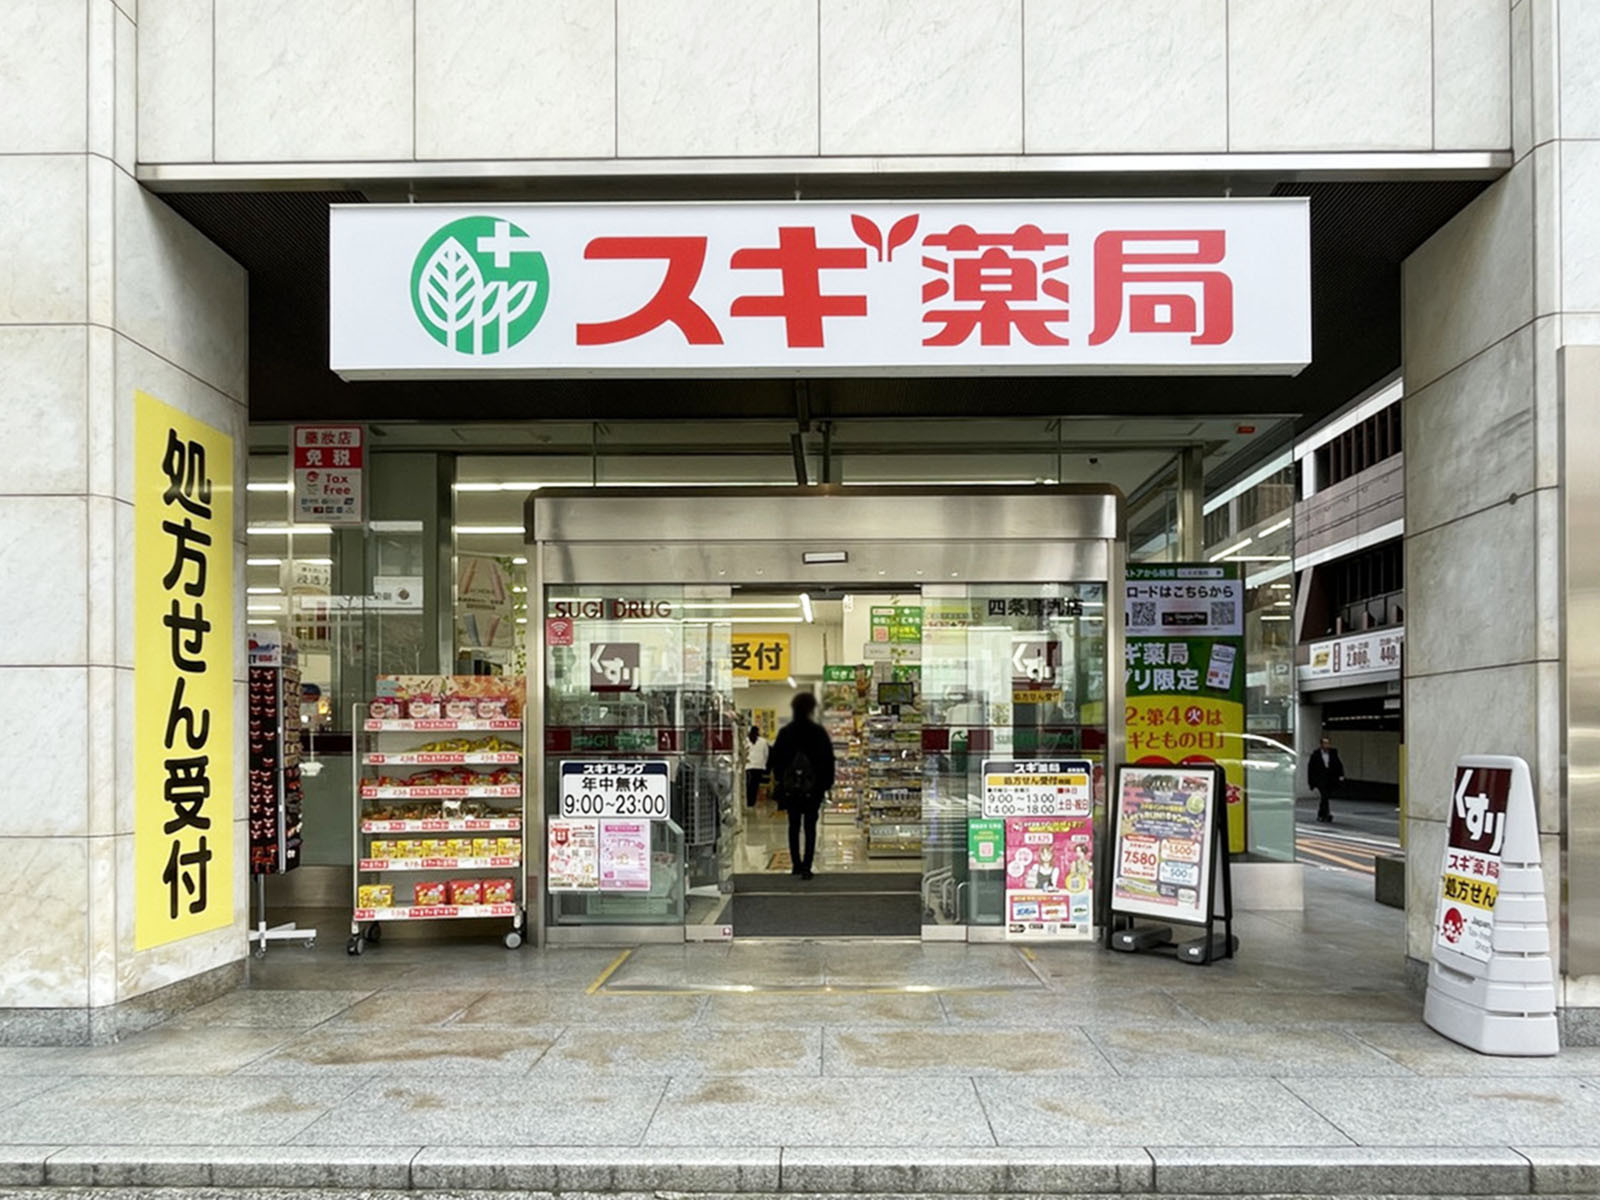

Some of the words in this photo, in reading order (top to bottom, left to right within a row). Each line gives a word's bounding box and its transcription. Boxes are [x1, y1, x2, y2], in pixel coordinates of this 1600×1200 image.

[576, 213, 1234, 347] スギ薬局
[324, 485, 351, 495] Free
[326, 473, 349, 484] Tax
[554, 601, 604, 619] SUGI
[613, 600, 672, 618] DRUG
[590, 644, 640, 690] くすり
[731, 642, 784, 671] 受付
[161, 427, 212, 920] 処方せん受付
[583, 764, 646, 774] スギドラッグ
[582, 777, 649, 793] 年中無休
[1455, 769, 1505, 854] くすり
[1448, 854, 1500, 878] スギ薬局
[1445, 877, 1497, 908] 処方せん
